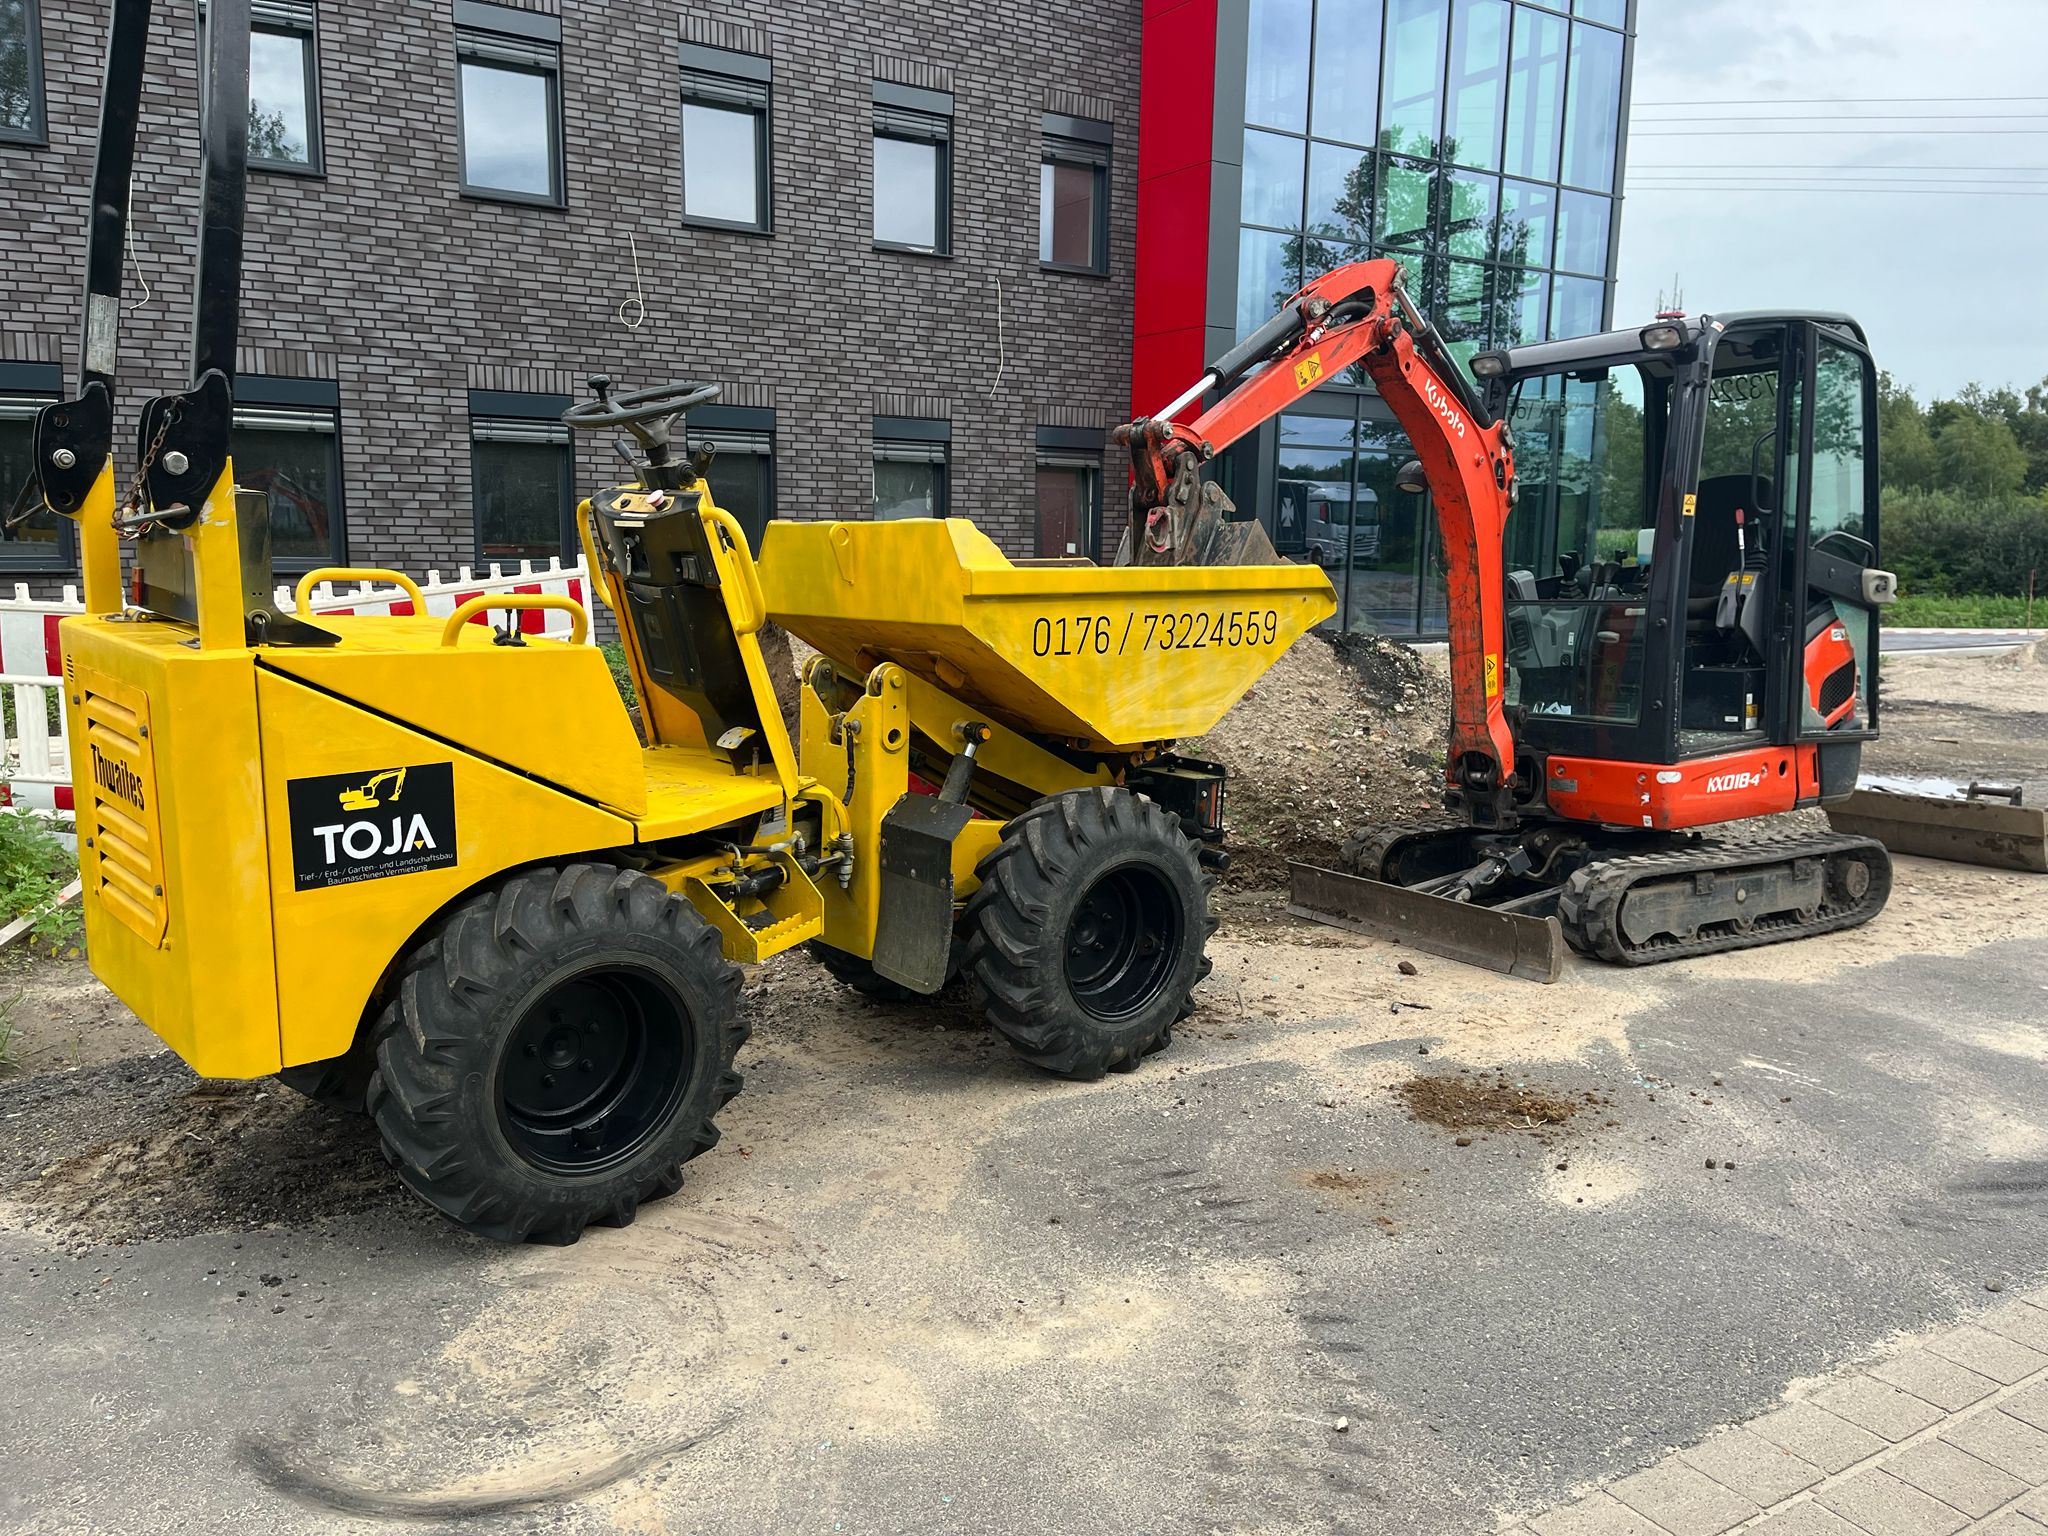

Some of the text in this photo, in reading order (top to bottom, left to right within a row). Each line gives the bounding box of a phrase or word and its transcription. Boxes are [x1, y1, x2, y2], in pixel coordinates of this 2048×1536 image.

[1425, 377, 1465, 438] Kubota
[1033, 610, 1278, 656] 0176 / 73224559
[90, 743, 145, 811] Thwaites
[1706, 772, 1760, 793] KX018-4
[313, 813, 437, 864] TOJA
[379, 860, 394, 870] und
[395, 852, 453, 867] Landschaftsbau
[327, 863, 428, 886] Baumaschinen Vermietung
